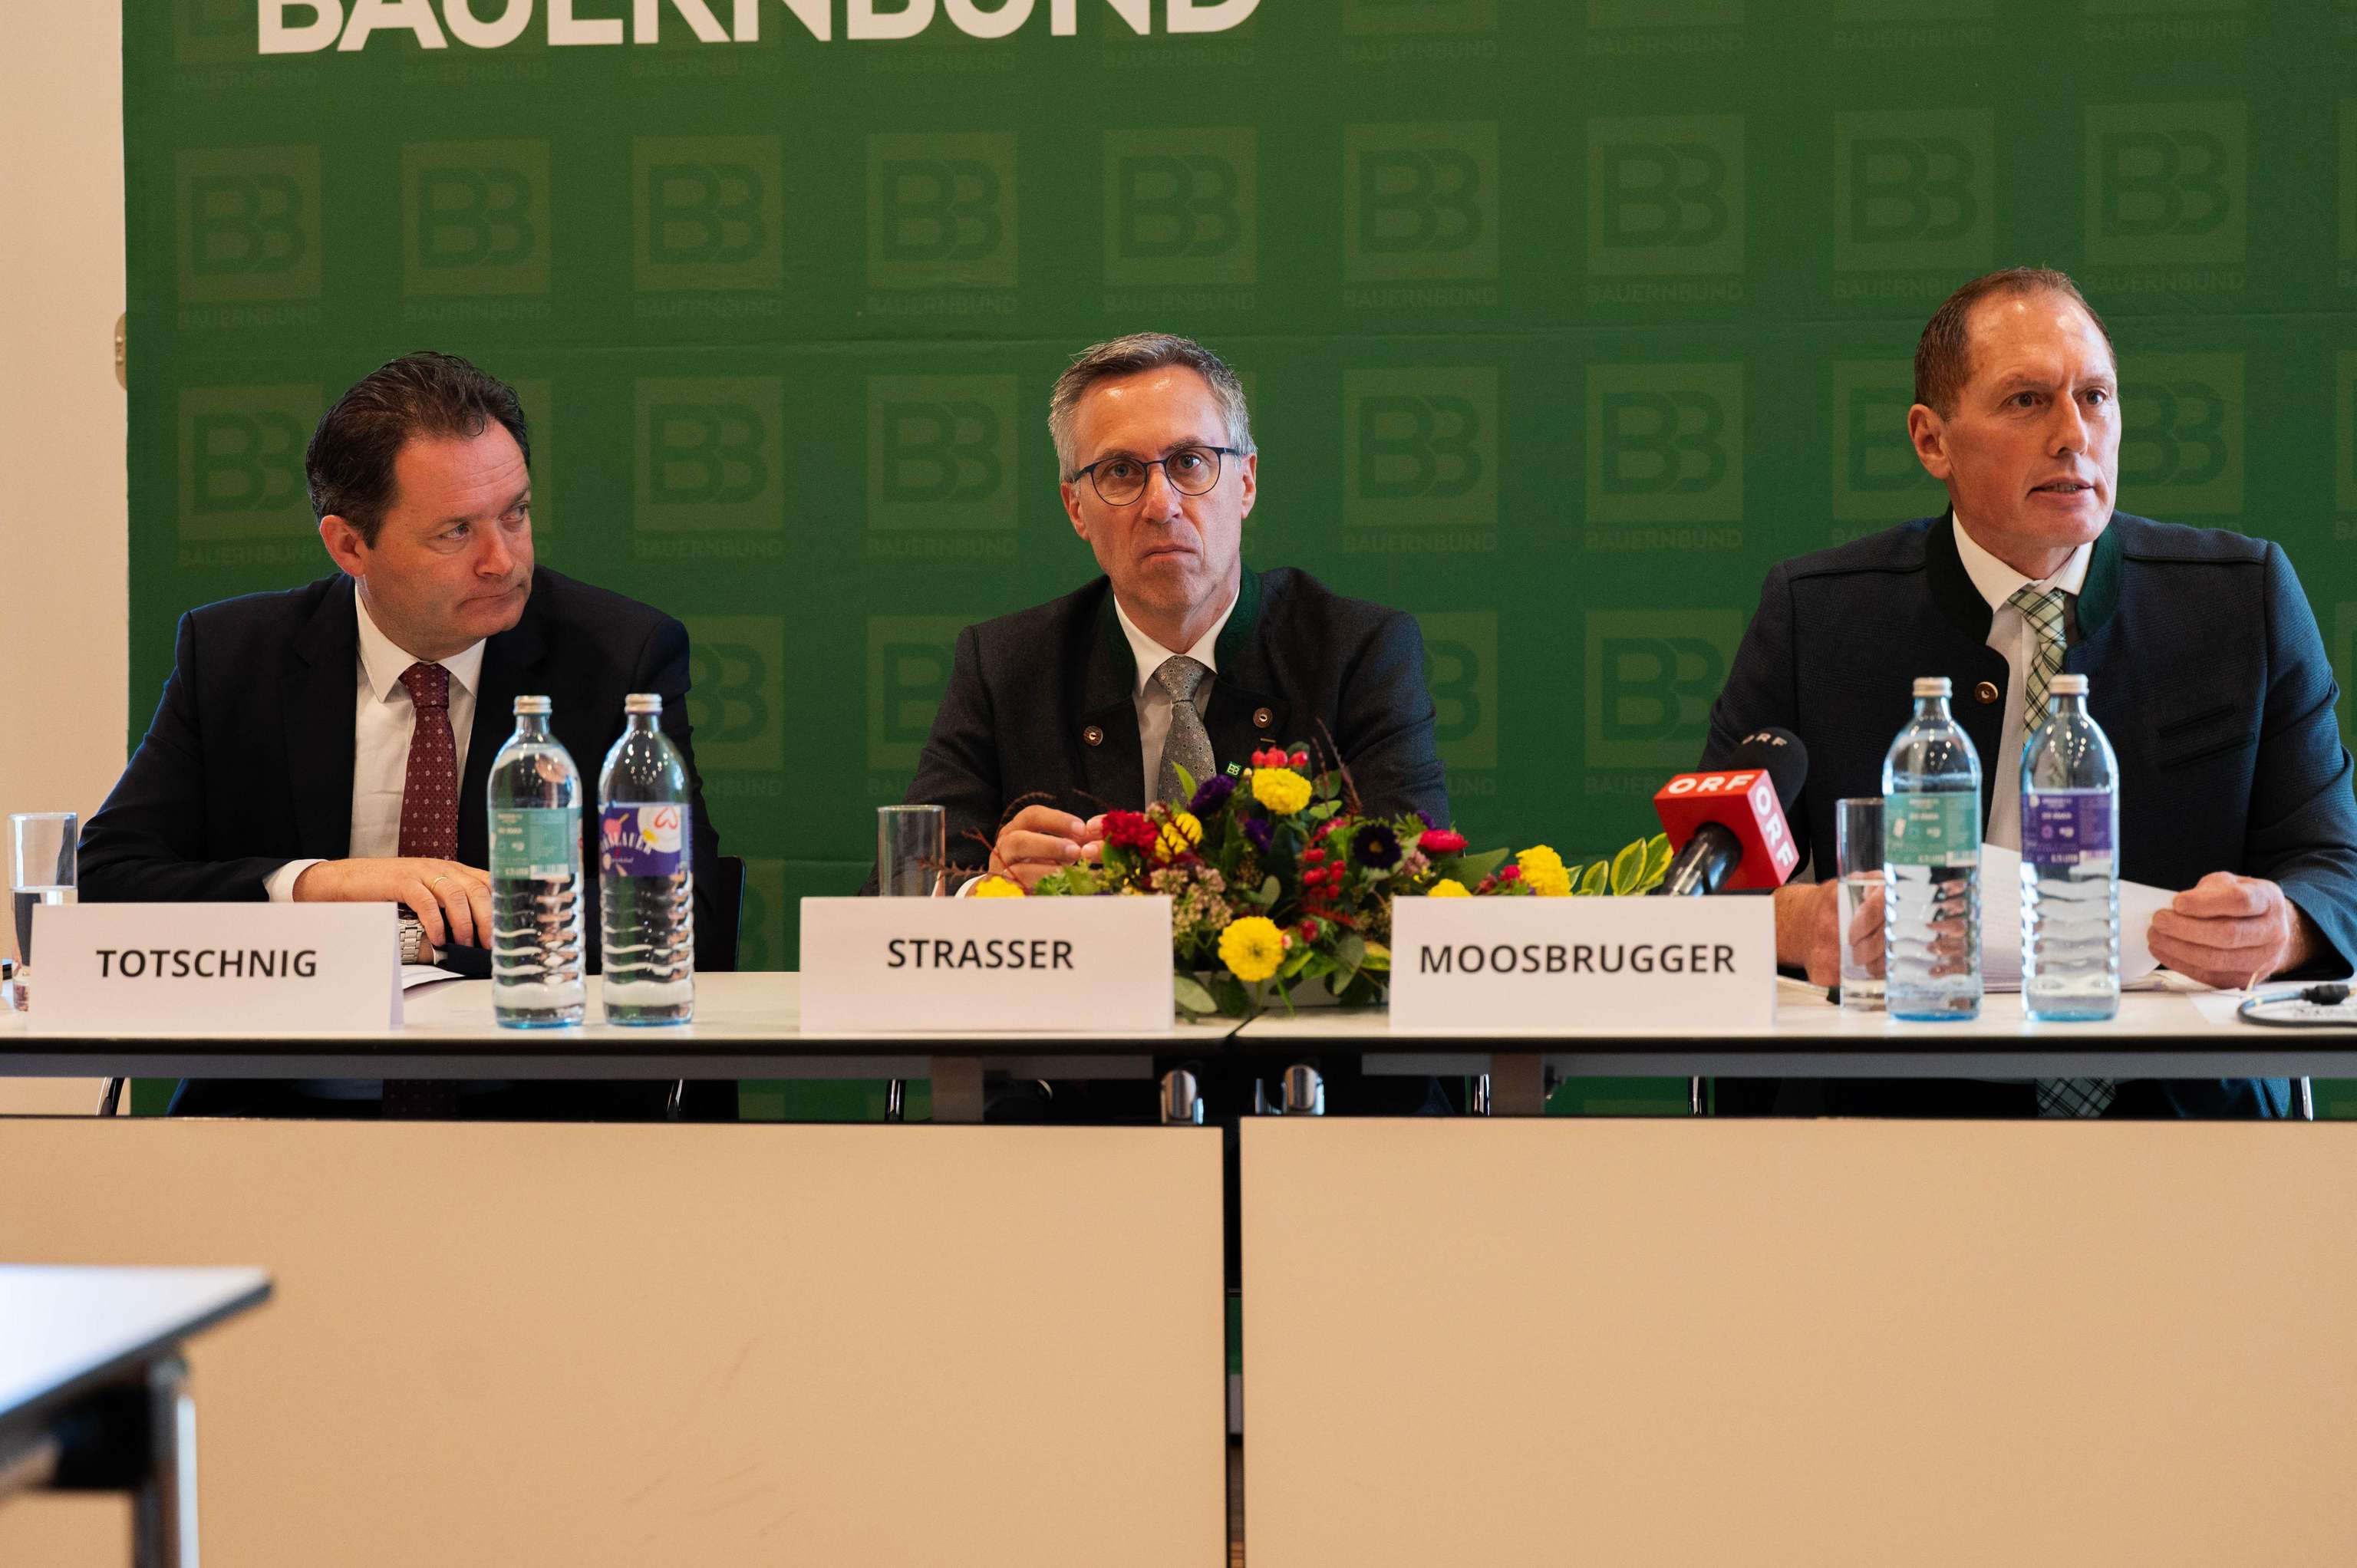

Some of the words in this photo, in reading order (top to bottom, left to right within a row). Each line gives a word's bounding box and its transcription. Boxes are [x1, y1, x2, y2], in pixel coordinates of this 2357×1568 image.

[192, 173, 306, 275] BB
[417, 166, 536, 268] BB
[648, 162, 764, 265] BB
[882, 159, 1002, 262] BB
[1119, 155, 1241, 259] BB
[1359, 148, 1482, 254] BB
[1602, 142, 1729, 249] BB
[1851, 136, 1978, 244] BB
[2099, 129, 2230, 237] BB
[650, 403, 767, 506] BB
[883, 400, 1001, 504] BB
[1359, 394, 1482, 499] BB
[1602, 390, 1728, 495] BB
[1667, 774, 1755, 795] ORF
[1755, 785, 1795, 868] ORF
[96, 950, 318, 978] TOTSCHNIG
[887, 938, 1074, 970] STRASSER
[1419, 944, 1737, 974] MOOSBRUGGER
